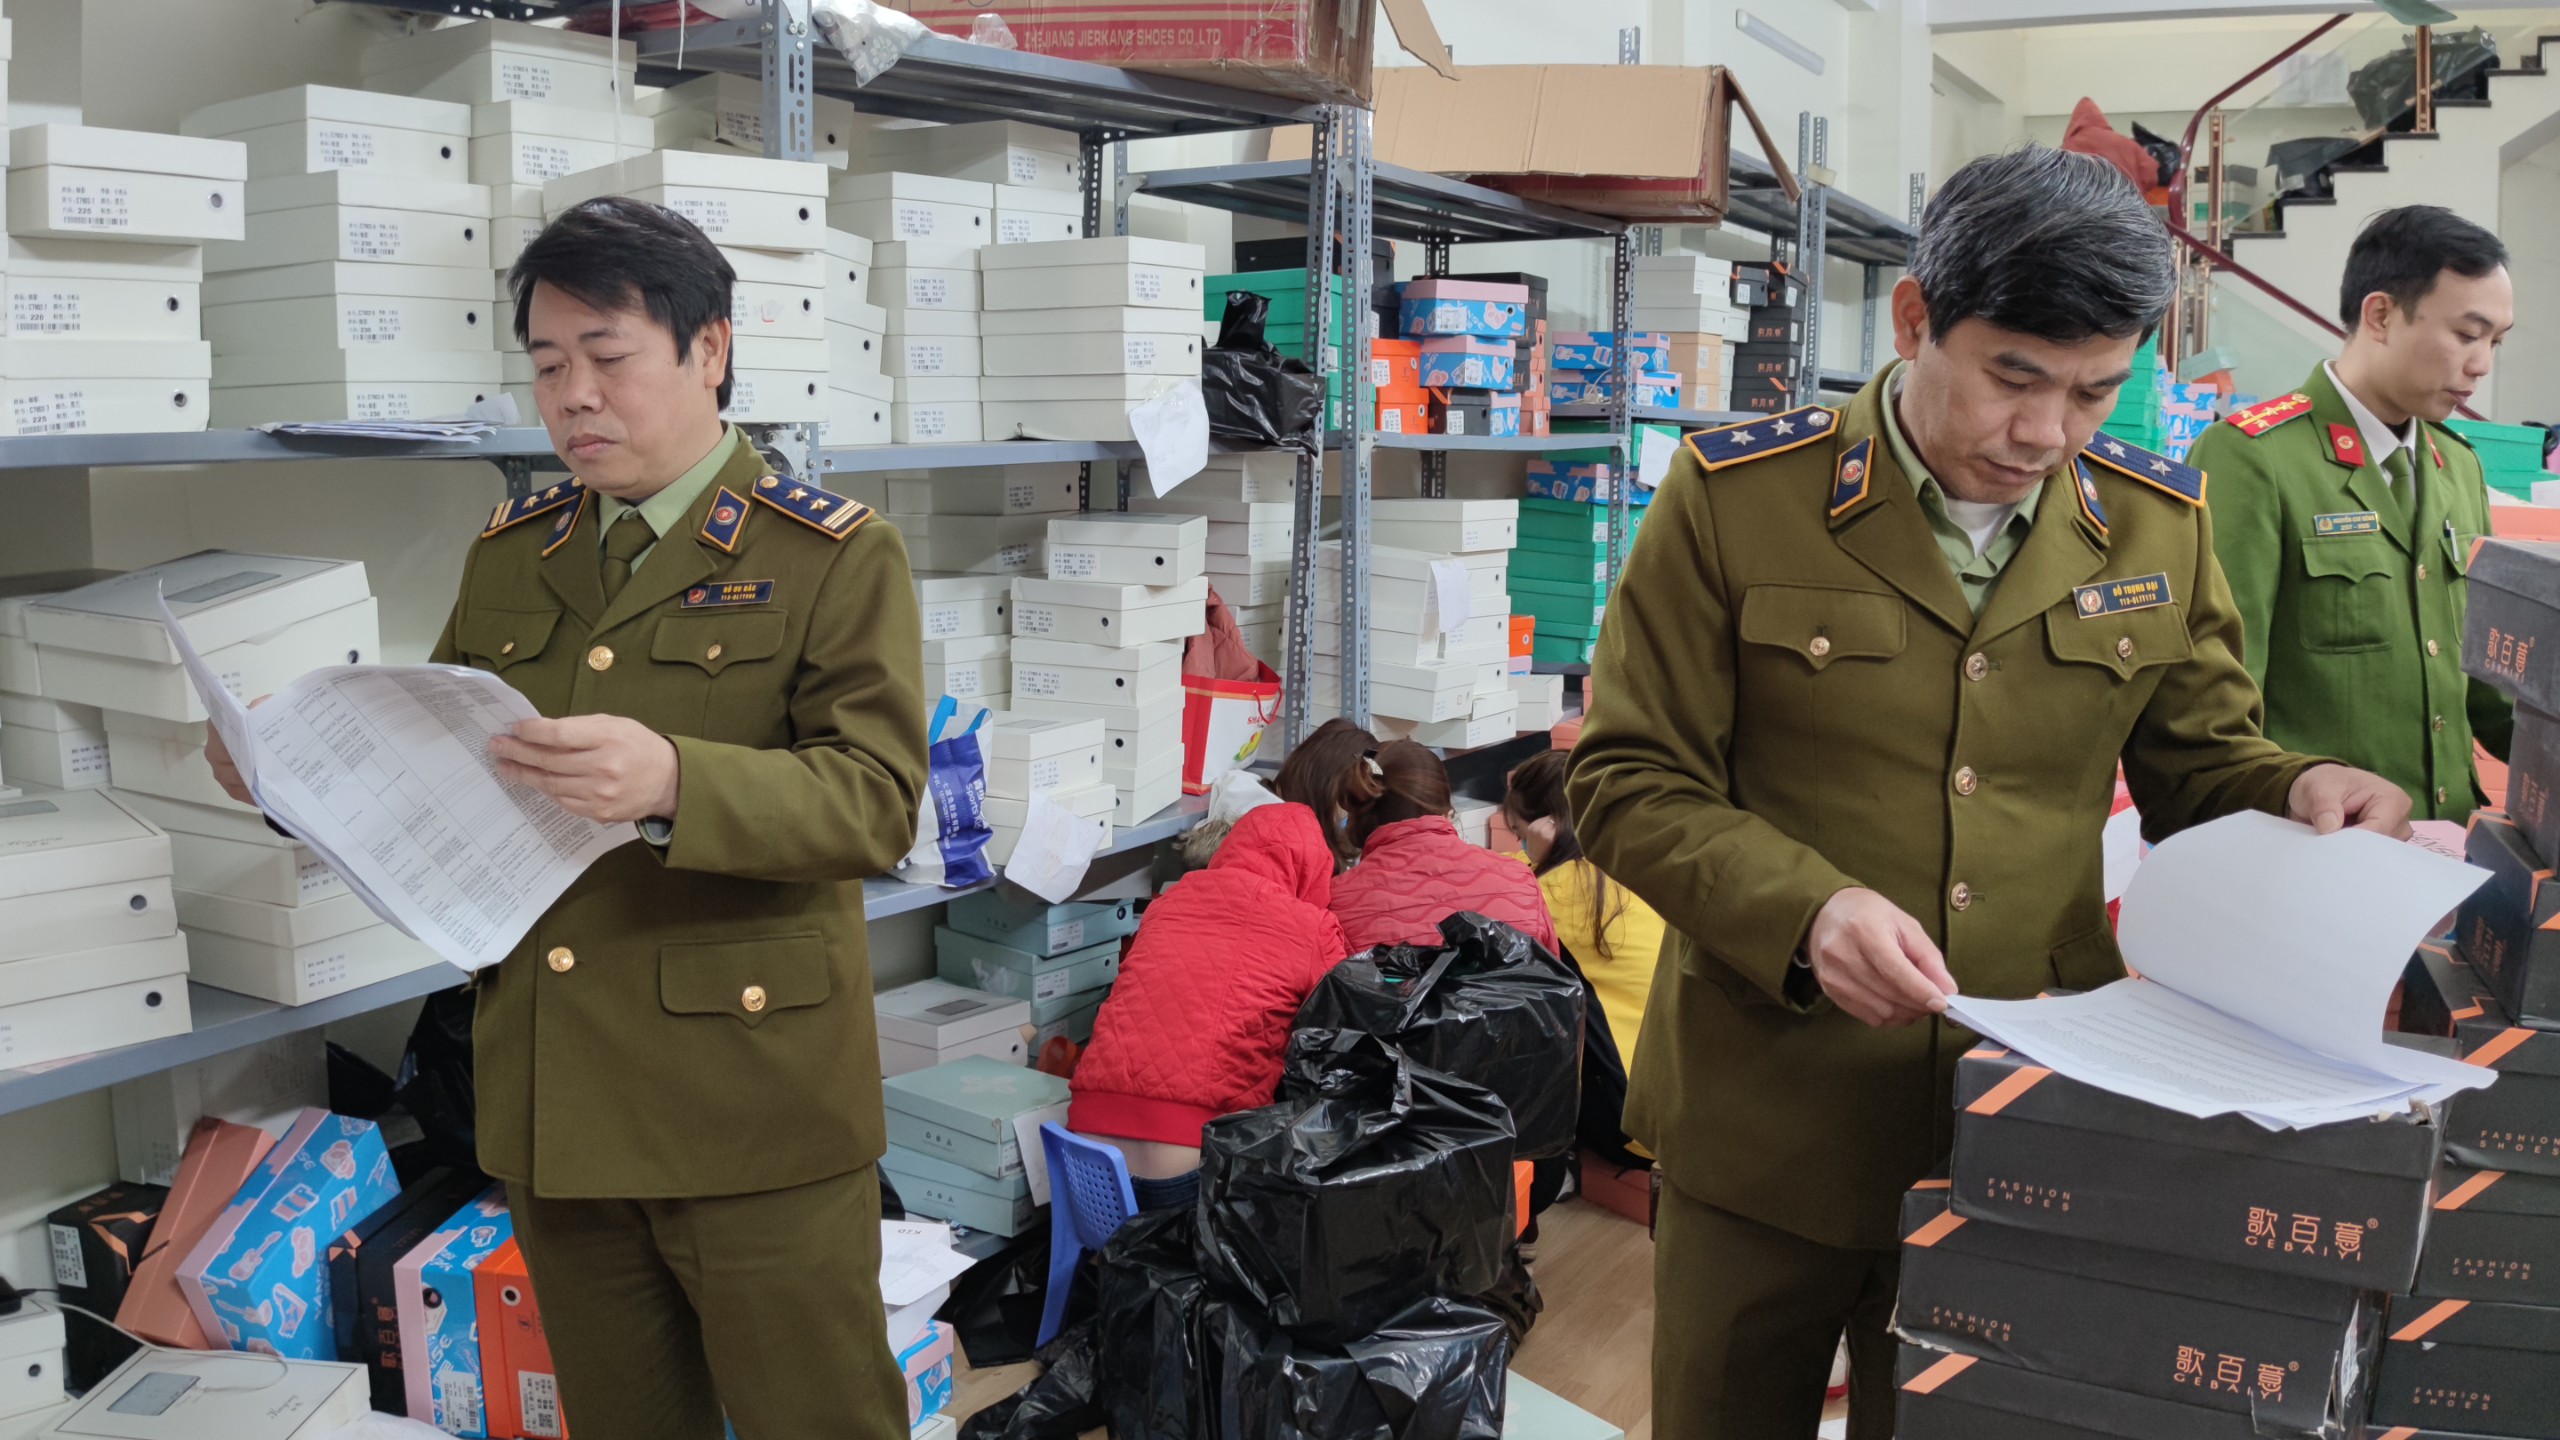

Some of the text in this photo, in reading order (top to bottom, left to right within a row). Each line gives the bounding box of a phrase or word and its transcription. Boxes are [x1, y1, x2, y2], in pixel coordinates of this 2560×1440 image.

[1025, 30, 1075, 49] ZHEJIANG
[1078, 29, 1133, 47] JIERKANG
[1137, 28, 1175, 46] SHOES
[966, 783, 979, 816] Sports
[2480, 1130, 2560, 1146] FASHION
[2480, 1140, 2560, 1156] SHOES
[1988, 1178, 2071, 1200] FASHION
[1988, 1188, 2069, 1212] SHOES
[2247, 1206, 2364, 1252] 歌百意
[2245, 1236, 2362, 1262] GEBAIYI
[2452, 1267, 2529, 1280] SHOES
[2453, 1258, 2530, 1271] FASHION
[1933, 1306, 2012, 1332] FASHION
[1933, 1316, 2010, 1342] SHOES
[2176, 1345, 2285, 1392] 歌百意
[2173, 1372, 2283, 1403] GEBAIYI
[2415, 1386, 2491, 1402] FASHION
[2413, 1396, 2489, 1411] SHOES
